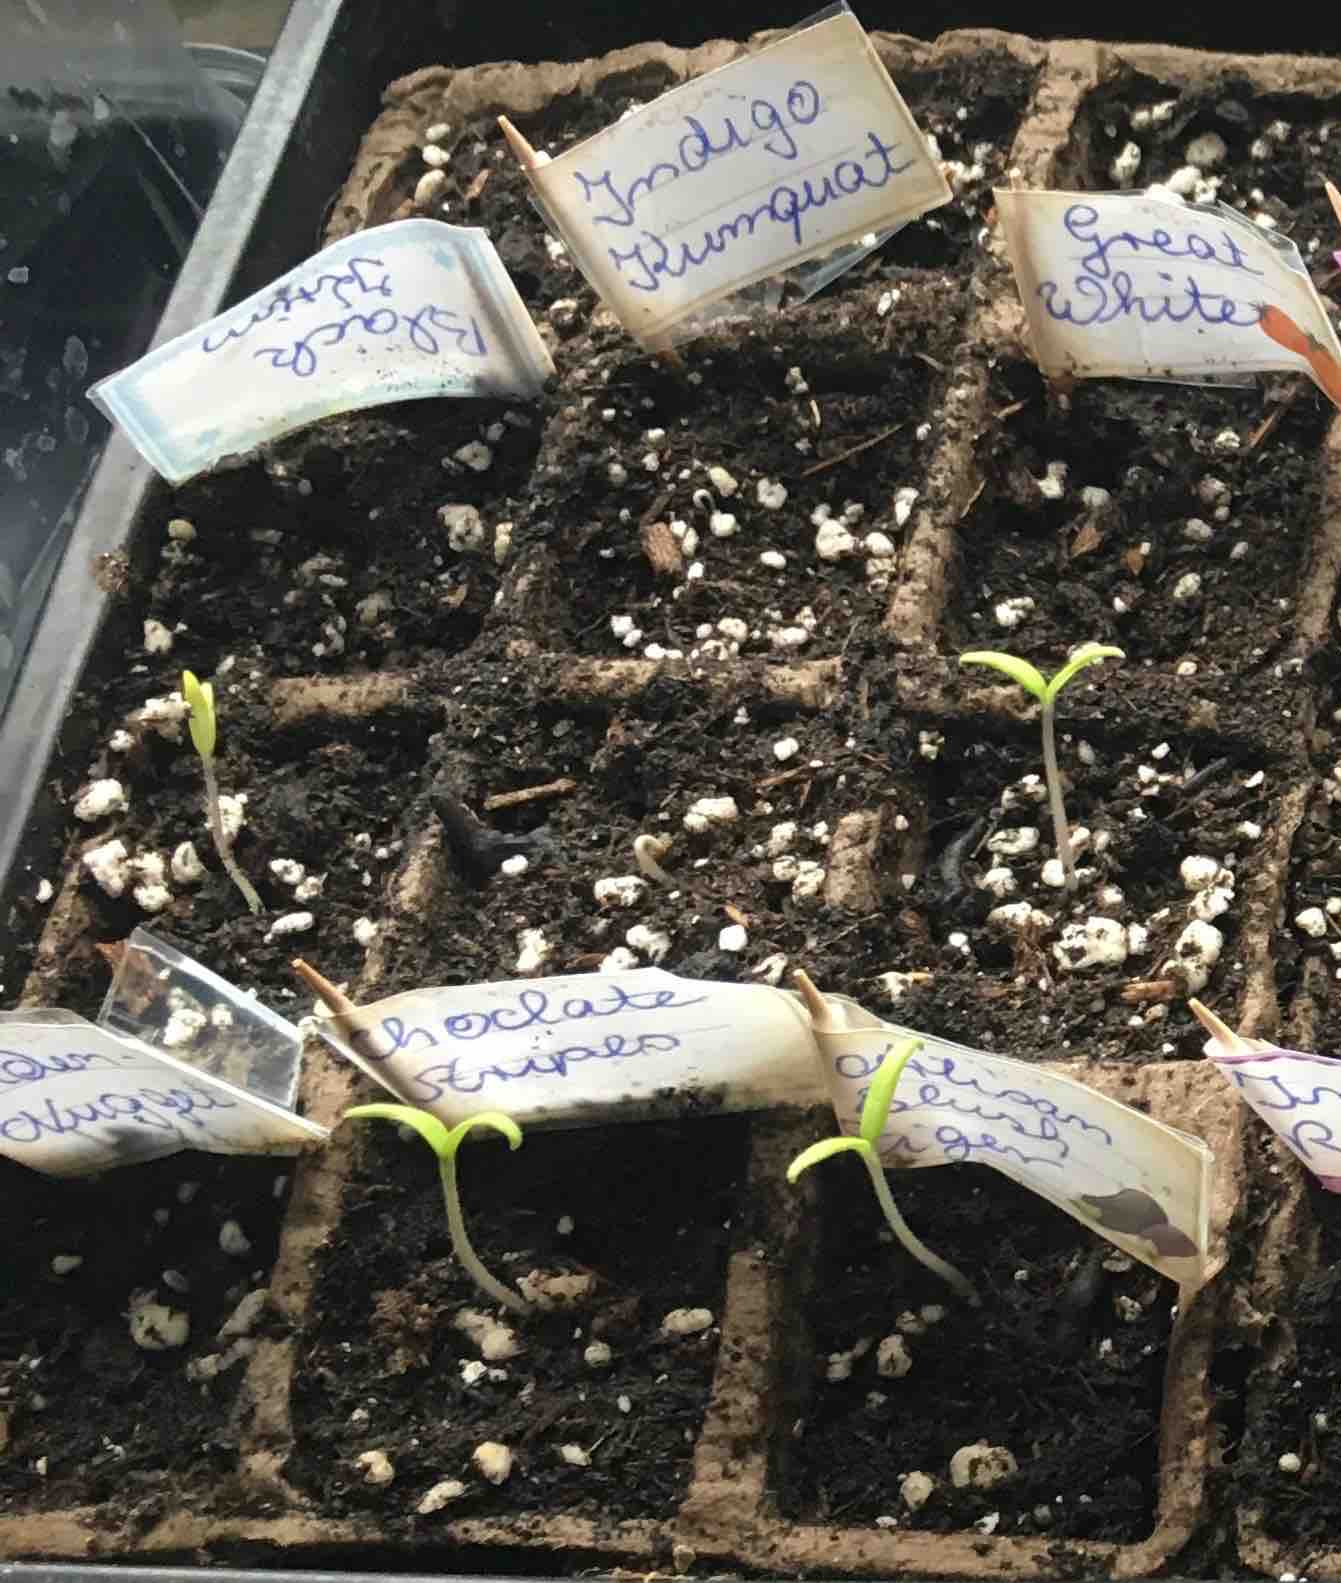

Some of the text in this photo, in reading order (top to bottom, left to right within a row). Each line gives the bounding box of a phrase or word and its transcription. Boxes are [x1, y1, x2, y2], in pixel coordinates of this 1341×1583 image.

[574, 81, 819, 226] Indigo
[608, 132, 916, 291] Kumquat
[1064, 205, 1263, 276] Great
[1039, 272, 1268, 326] White
[254, 305, 487, 377] Black
